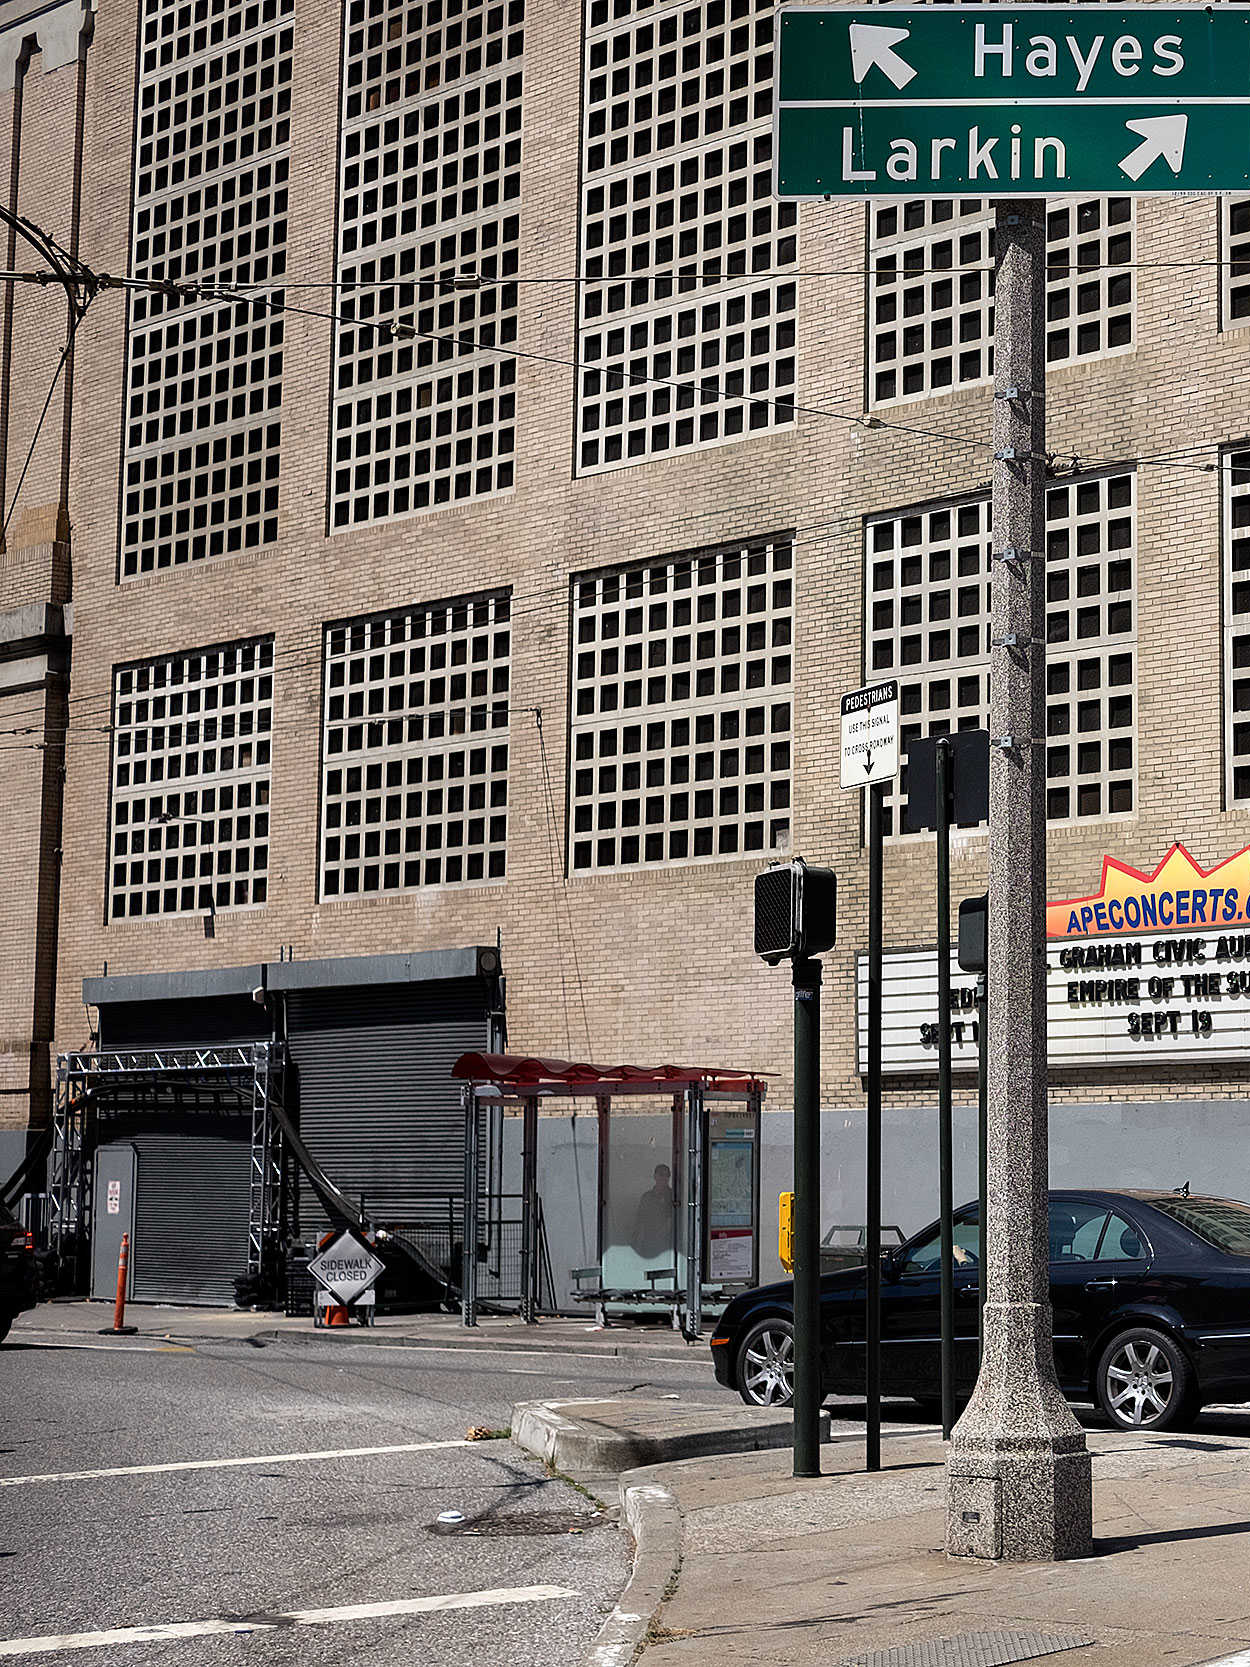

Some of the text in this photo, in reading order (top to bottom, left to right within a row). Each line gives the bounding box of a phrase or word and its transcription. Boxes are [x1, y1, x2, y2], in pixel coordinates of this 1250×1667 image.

[974, 23, 1185, 92] Hayes
[842, 124, 1067, 181] Larkin
[845, 685, 893, 711] PEDESTRIANS
[848, 714, 890, 734] USE THIS SIGNAL
[845, 736, 894, 757] TO CROSS ROADWAY
[1060, 942, 1142, 968] GRAHAM
[1152, 938, 1207, 962] CIVIC
[1067, 978, 1140, 1002] EMPIRE
[1148, 976, 1174, 998] OF
[1180, 973, 1221, 996] THE
[1127, 1009, 1212, 1035] SEPT 19
[320, 1259, 372, 1271] SIDEWALK
[326, 1271, 367, 1282] CLOSED
